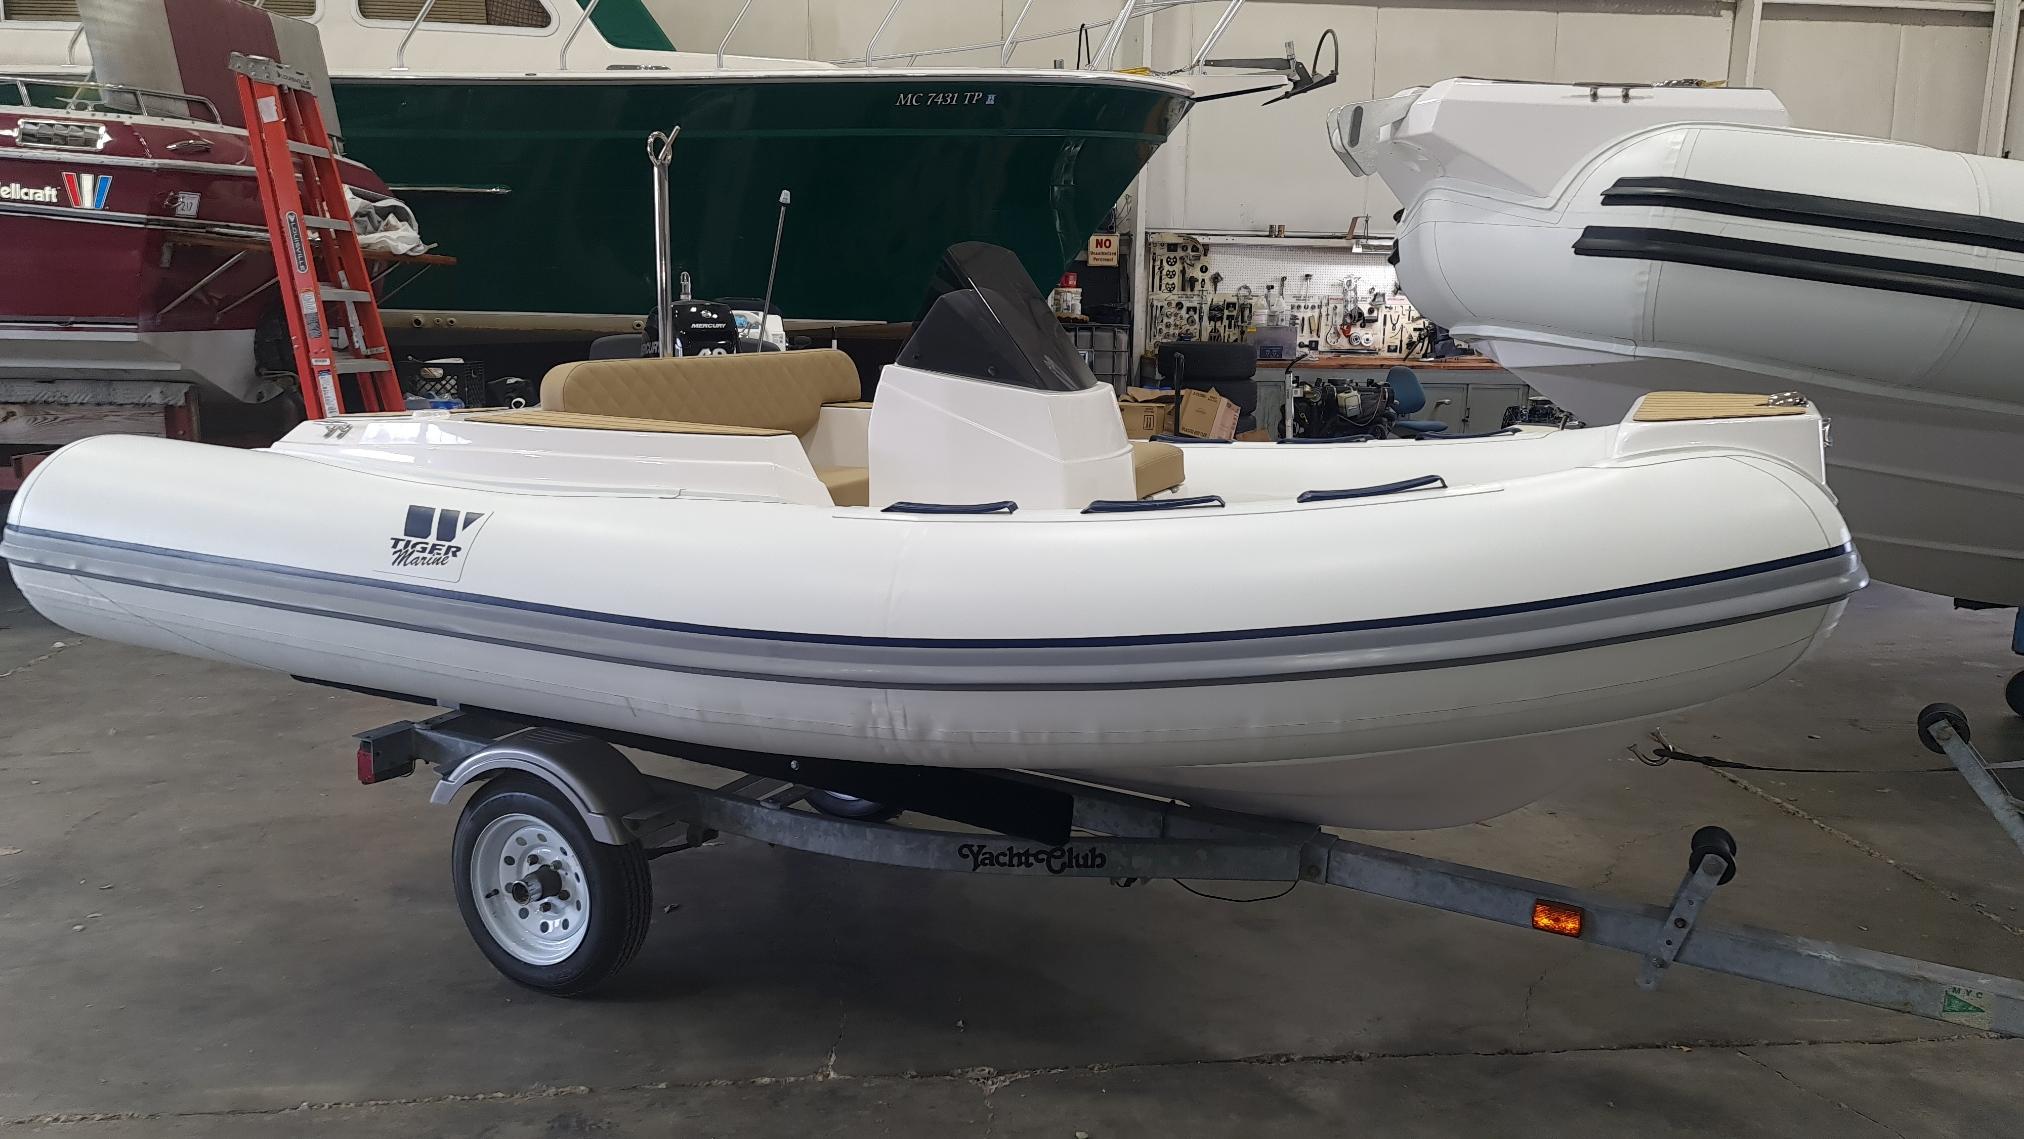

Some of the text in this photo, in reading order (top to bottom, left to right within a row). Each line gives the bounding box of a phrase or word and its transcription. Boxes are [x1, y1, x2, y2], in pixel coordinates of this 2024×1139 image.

[895, 93, 923, 106] MC
[926, 92, 959, 105] 7431
[963, 92, 983, 105] TP
[0, 183, 58, 203] ellcraft
[1095, 238, 1112, 249] NO
[390, 537, 462, 558] TIGER
[392, 548, 450, 567] Marine
[957, 843, 1107, 874] Yacht Club
